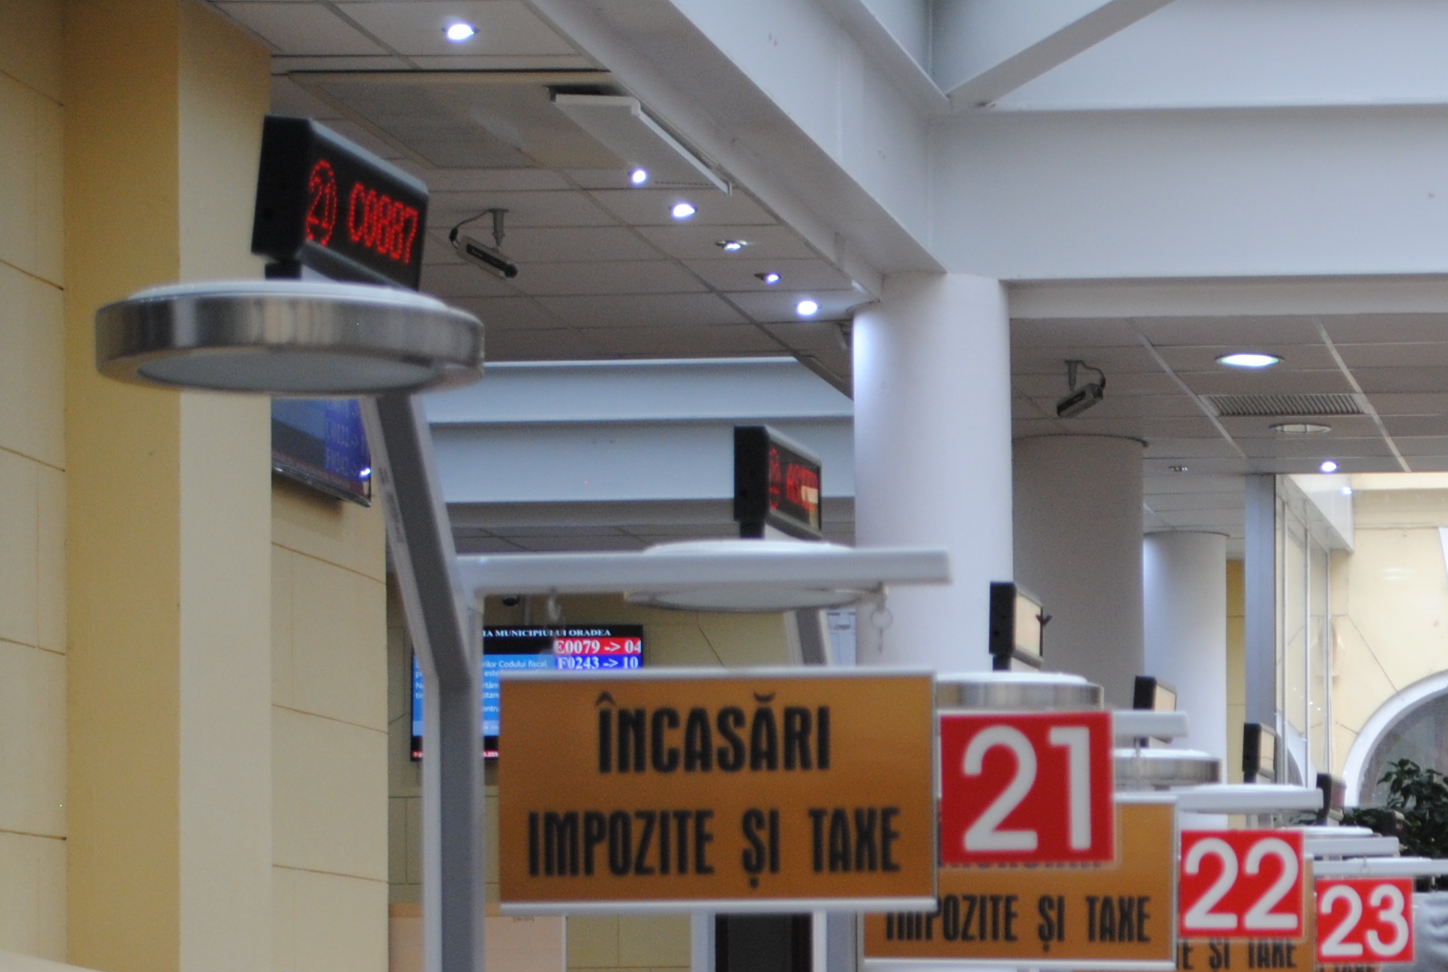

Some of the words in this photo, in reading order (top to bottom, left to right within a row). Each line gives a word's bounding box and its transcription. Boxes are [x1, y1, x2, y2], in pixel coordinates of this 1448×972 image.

[558, 656, 600, 670] F0243
[623, 656, 639, 670] 10
[568, 629, 612, 637] ORADEA
[624, 640, 642, 654] 04
[594, 691, 831, 774] ÎNCASĂRI
[961, 724, 1092, 852] 21
[528, 809, 715, 877] IMPOZITE
[808, 807, 900, 873] TAXE
[1184, 837, 1299, 930] 22
[886, 895, 1019, 942] IMPOZITE
[1085, 895, 1152, 943] TAXE
[1319, 884, 1409, 957] 23
